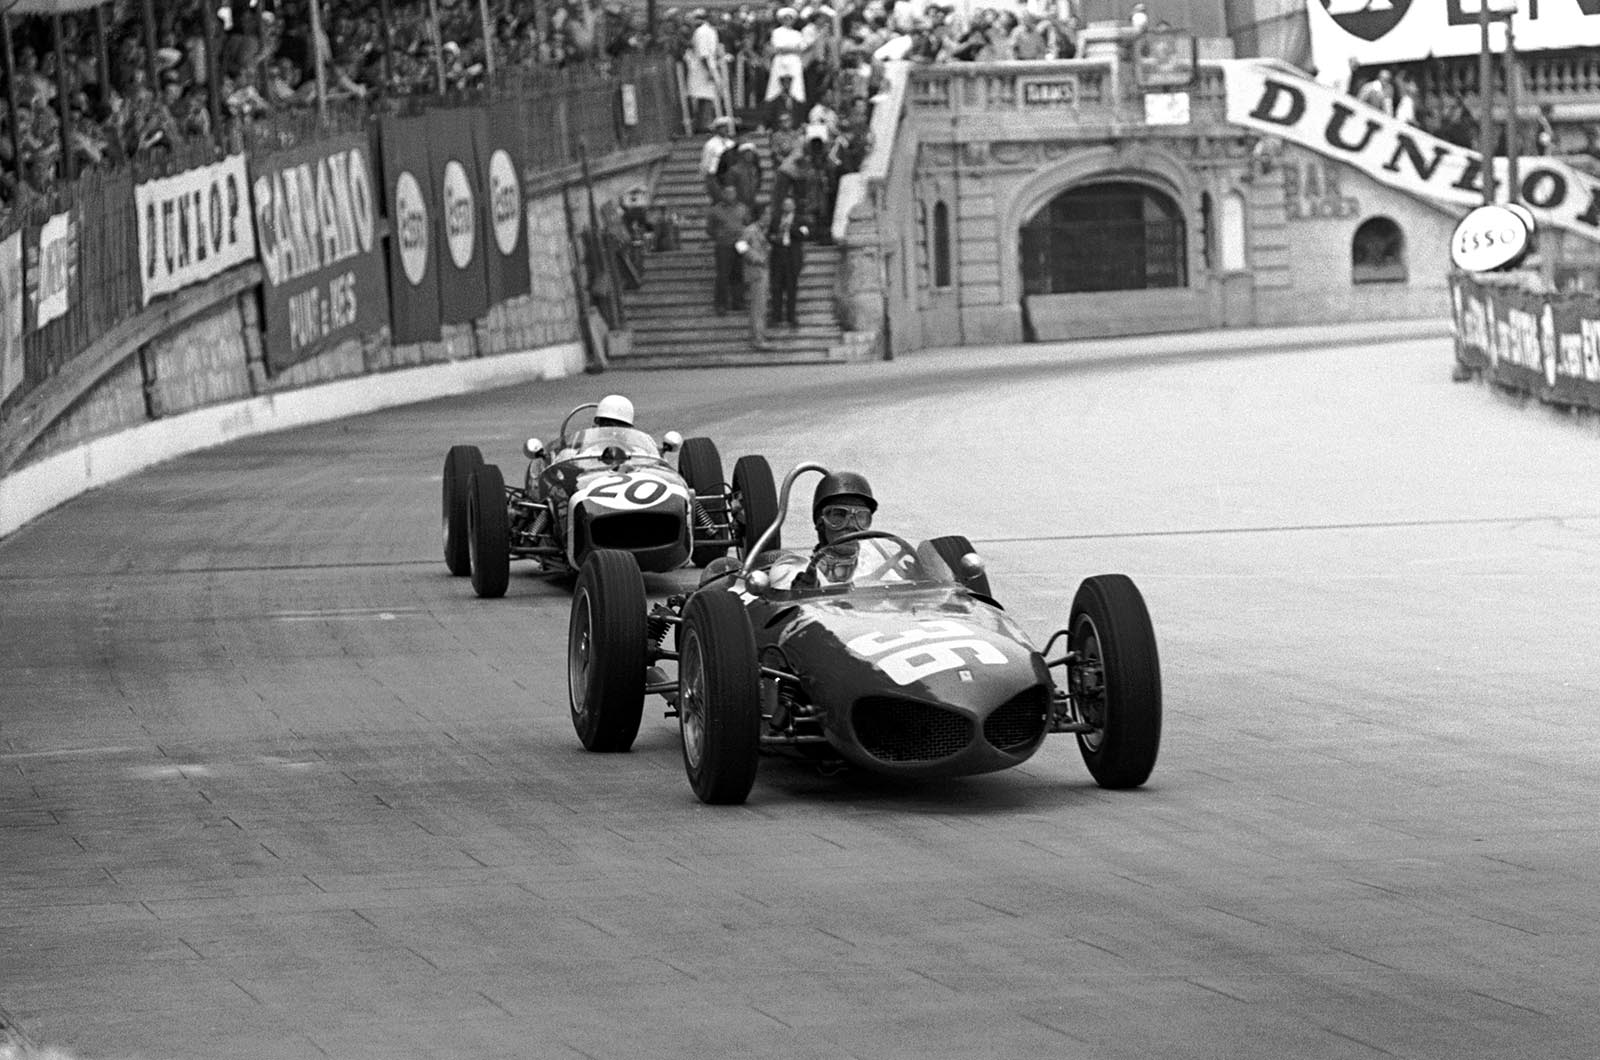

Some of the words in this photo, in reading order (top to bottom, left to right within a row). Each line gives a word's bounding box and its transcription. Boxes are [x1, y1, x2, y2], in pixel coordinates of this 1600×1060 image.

[146, 172, 239, 278] DUNLOP
[254, 149, 373, 287] CARPANO
[585, 474, 668, 506] 20
[846, 619, 1010, 687] 36
